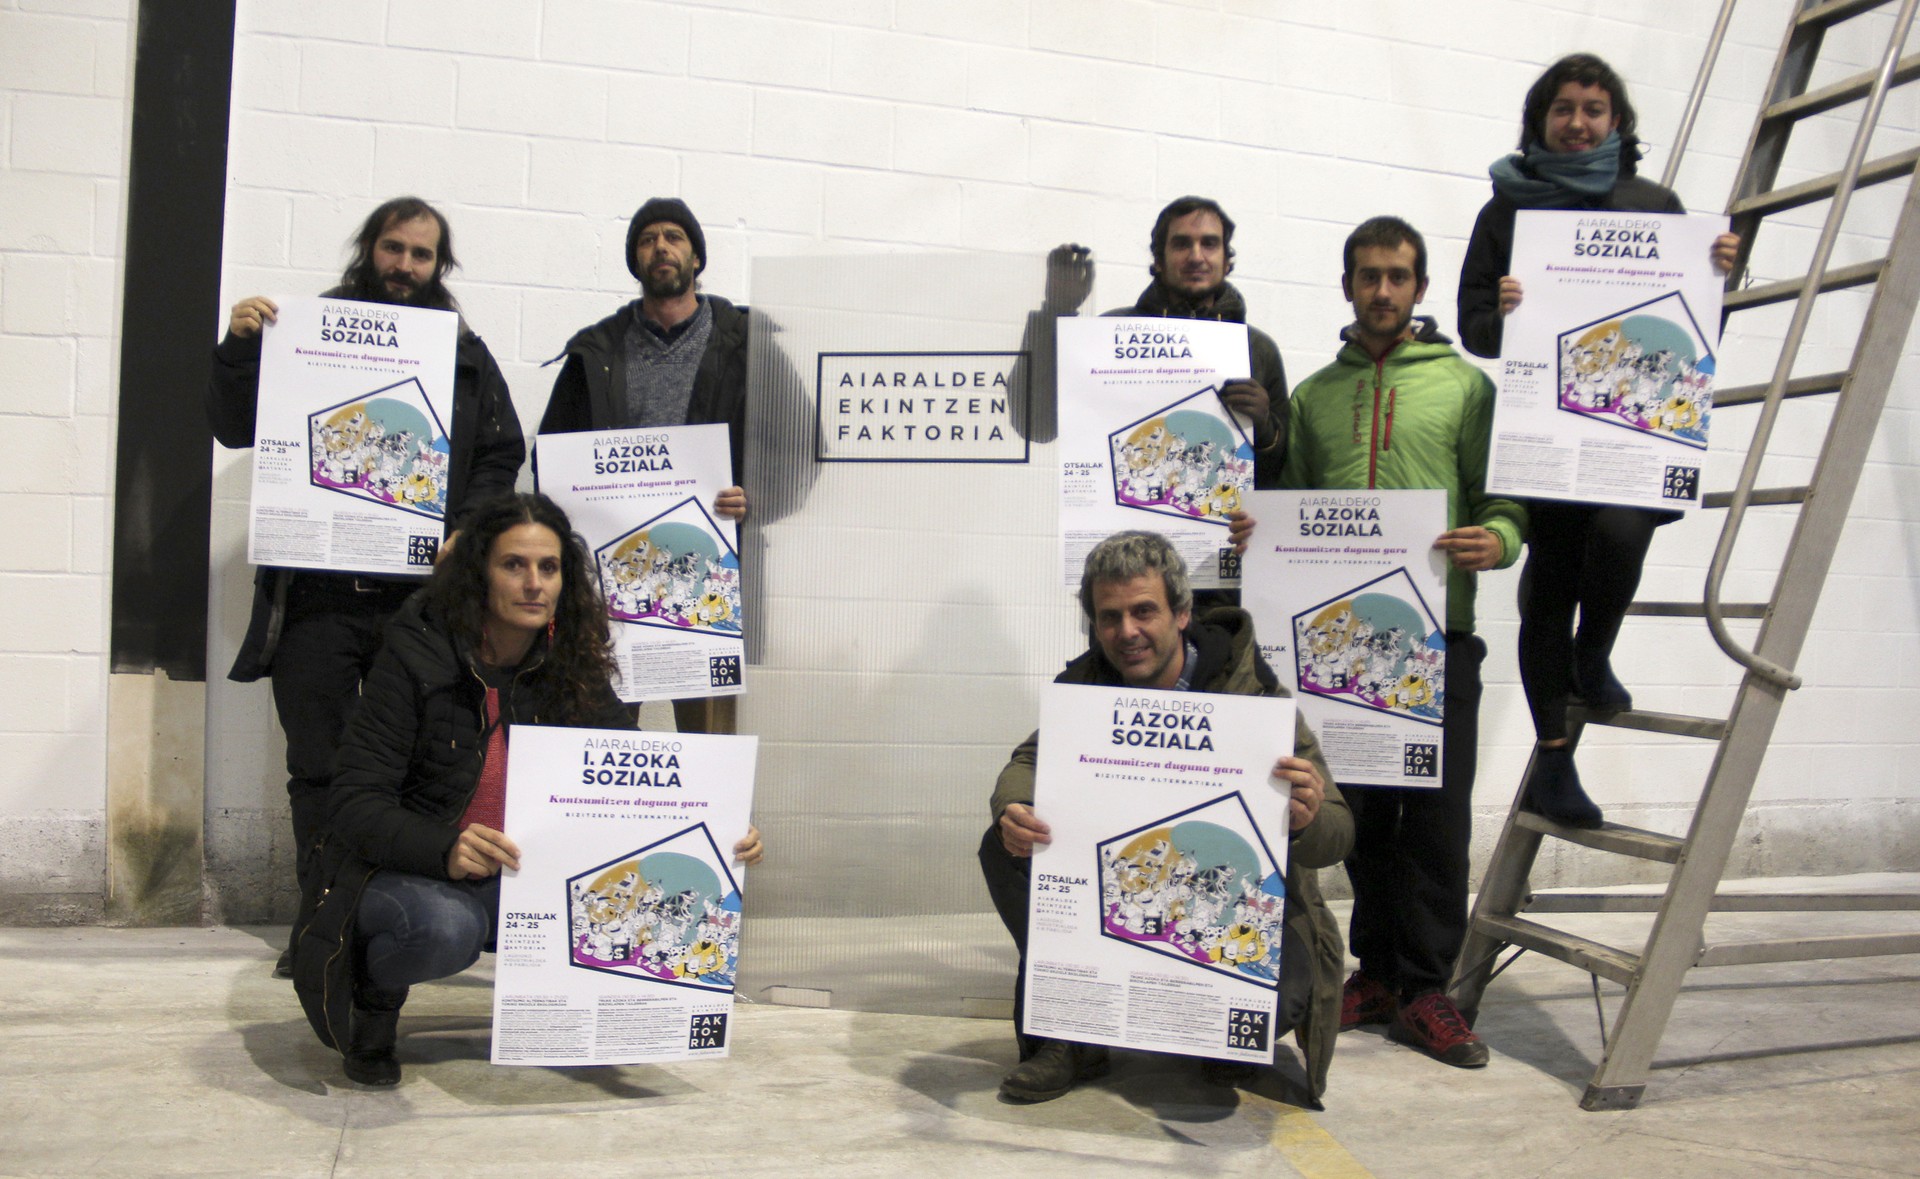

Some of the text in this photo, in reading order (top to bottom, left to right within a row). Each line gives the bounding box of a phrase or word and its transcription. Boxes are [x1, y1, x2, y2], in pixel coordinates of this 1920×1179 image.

[1576, 217, 1662, 230] AIARALDEKO
[1590, 228, 1660, 243] AZOKA
[1573, 242, 1661, 259] SOZIALA
[322, 304, 399, 320] AIARALDEKO
[321, 314, 398, 332] I. AZOKA
[320, 328, 399, 347] SOZIALA
[1128, 331, 1190, 345] AZOKA
[1114, 344, 1193, 359] SOZIALA
[1506, 360, 1548, 369] OTSAILAK
[840, 372, 1007, 387] AIARALDEA
[839, 399, 1005, 413] EKINTZEN
[593, 432, 669, 447] AIARALDEKO
[838, 425, 1004, 440] FAKTORIA
[260, 438, 300, 447] OTSAILAK
[593, 442, 669, 460] I. AZOKA
[594, 456, 673, 474] SOZIALA
[1666, 466, 1695, 478] FAK
[572, 478, 696, 491] Kontsumitzen duguna gara
[1664, 486, 1689, 498] RIA
[1300, 496, 1380, 506] AIARALDEKO
[1299, 507, 1380, 520] I. AZOKA
[1300, 522, 1383, 536] SOZIALA
[409, 536, 434, 546] FAK
[1343, 546, 1380, 554] duguna
[1383, 547, 1407, 555] gara
[408, 554, 430, 564] RIA
[1258, 644, 1286, 652] AILAK
[710, 657, 736, 666] FAK
[712, 676, 734, 684] RIA
[1114, 697, 1215, 713] AIARALDEKO
[1112, 709, 1213, 731] I. AZOKA
[584, 737, 682, 752] AIARALDEKO
[1111, 728, 1215, 751] SOZIALA
[1405, 744, 1433, 756] FAK
[583, 750, 681, 768] I. AZOKA
[1079, 754, 1243, 776] Kontsumitzen duguna gara
[1405, 764, 1429, 775] RIA
[582, 768, 683, 787] SOZIALA
[549, 794, 708, 809] Kontsumitzen duguna gara
[1039, 873, 1088, 885] OTSAILAK
[1038, 883, 1049, 891] 24
[1058, 885, 1070, 893] 25
[506, 912, 556, 920] OTSAILAK
[692, 1015, 722, 1026] FAK
[1230, 1009, 1264, 1025] FAK
[690, 1037, 716, 1047] RIA
[1229, 1034, 1258, 1048] RIA
